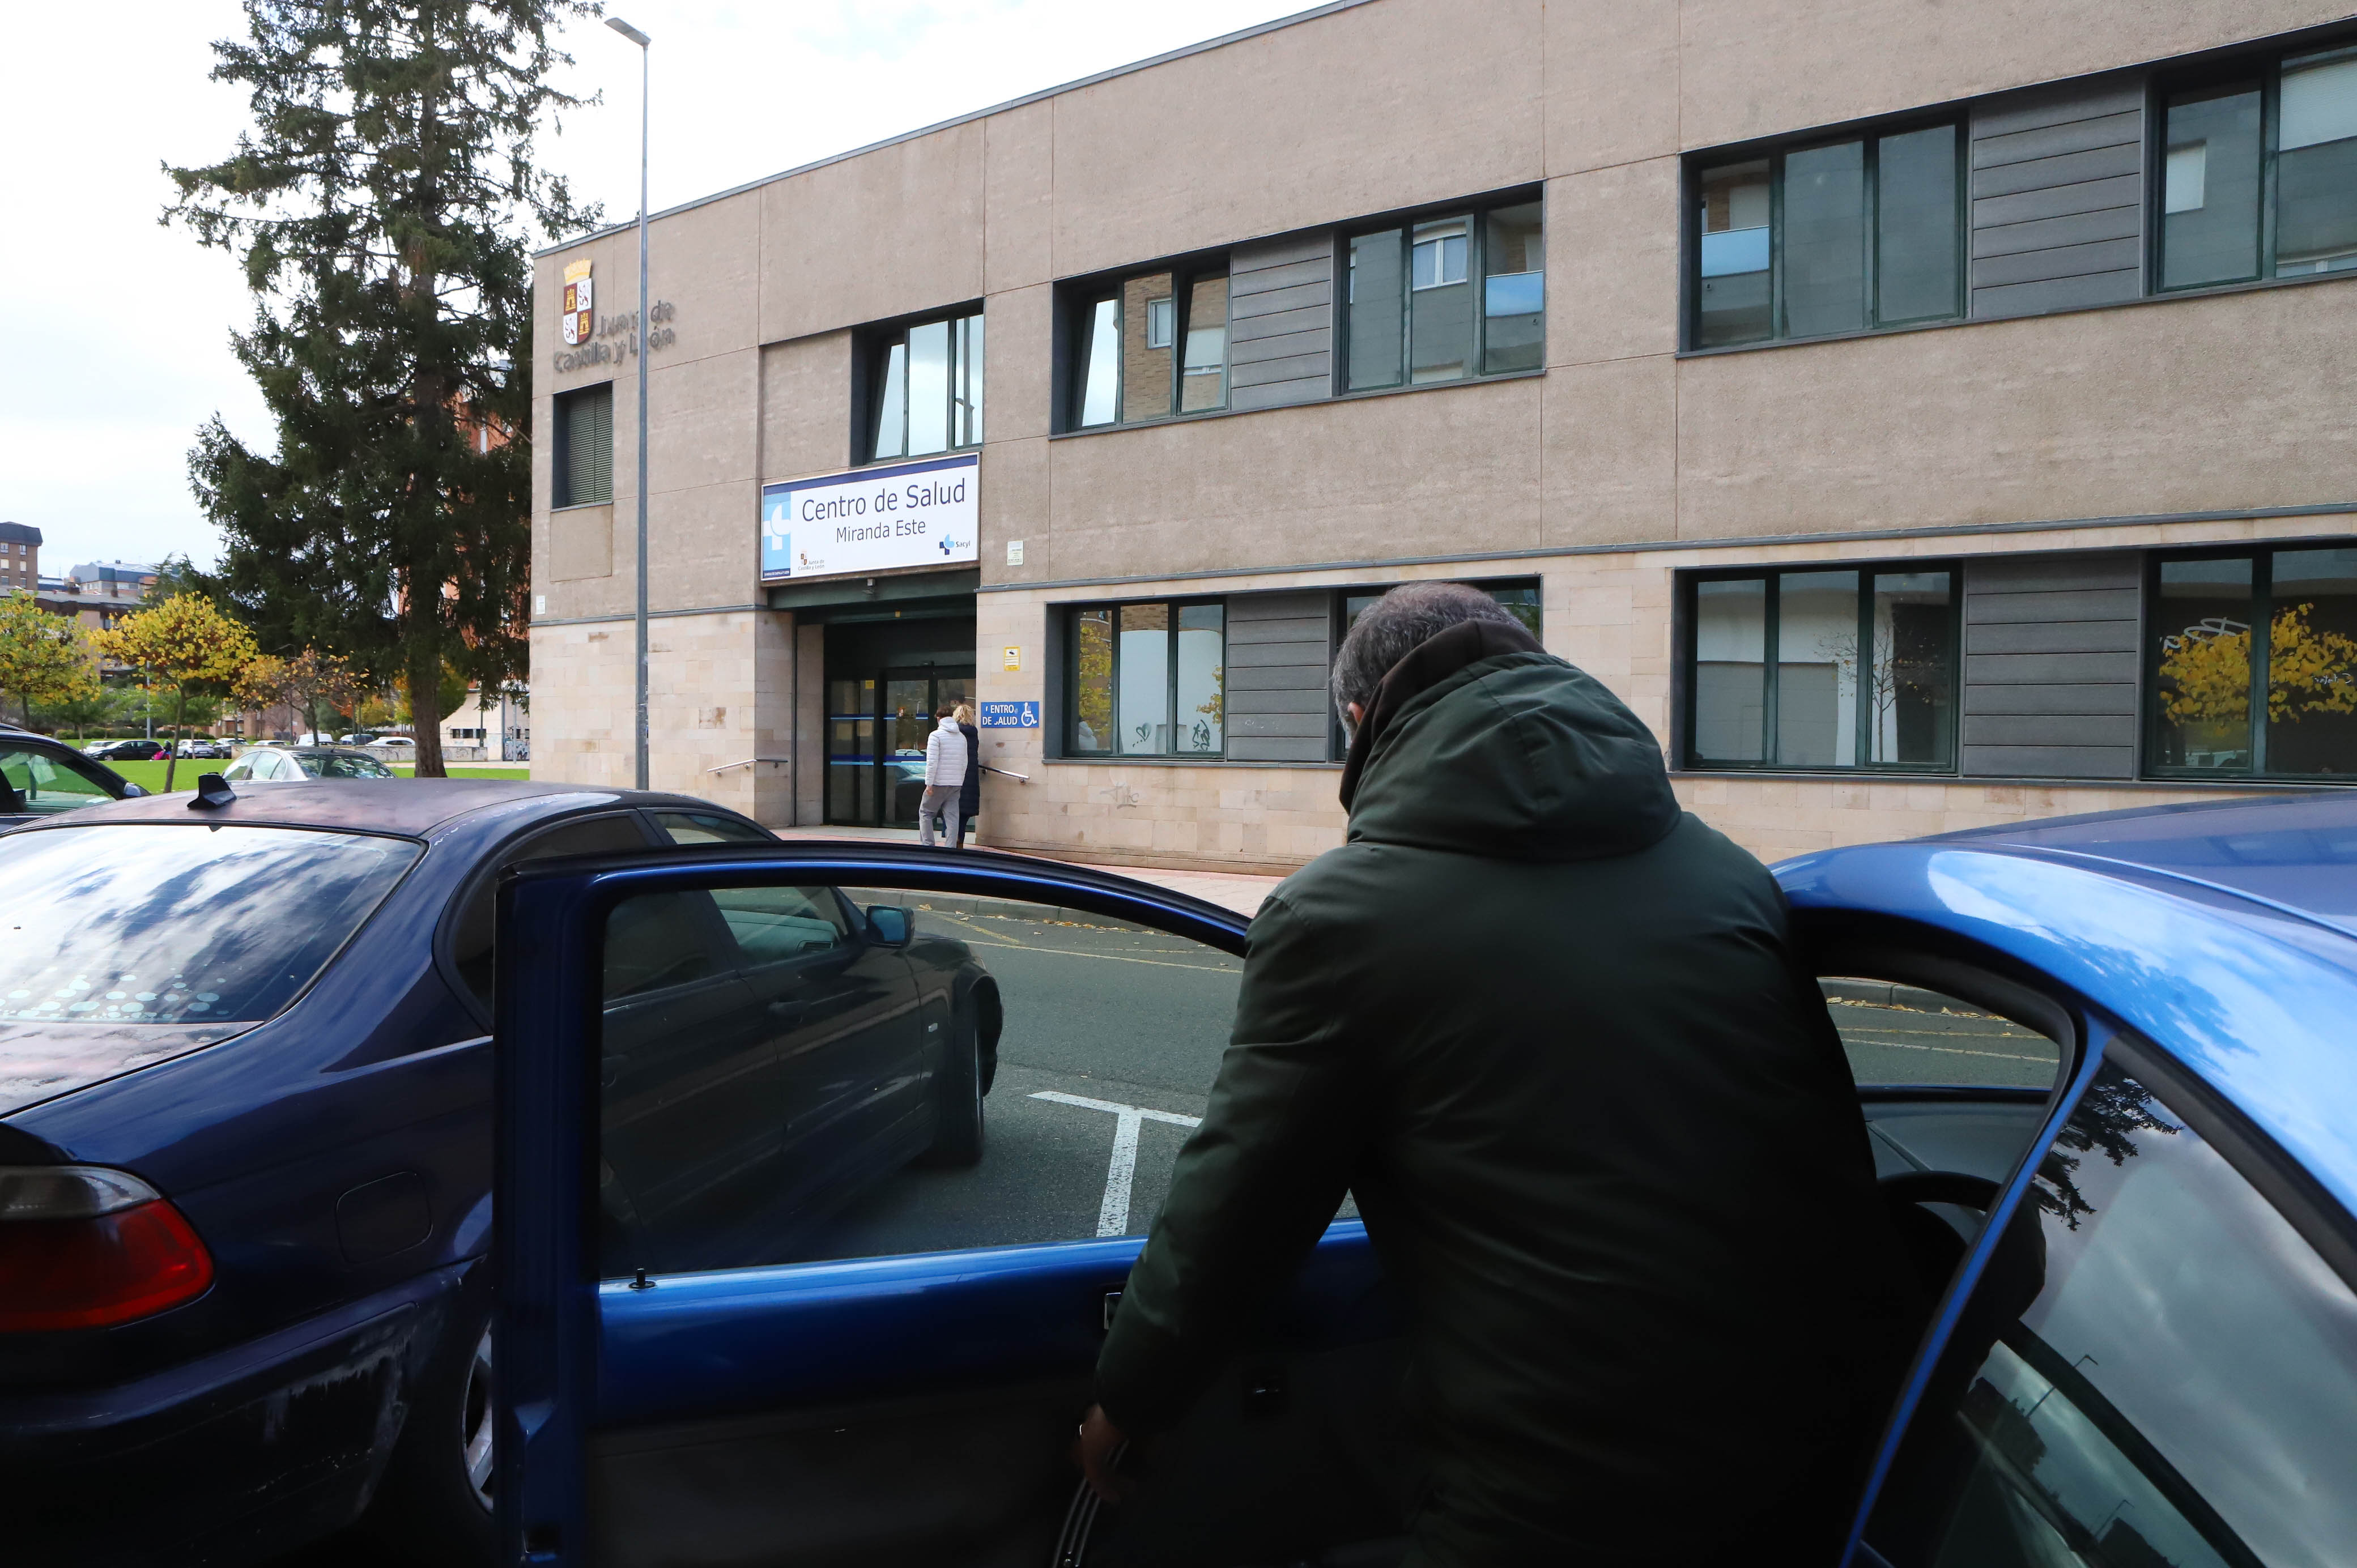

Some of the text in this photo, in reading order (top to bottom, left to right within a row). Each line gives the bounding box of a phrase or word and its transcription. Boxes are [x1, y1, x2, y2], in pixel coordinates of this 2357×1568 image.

[650, 300, 674, 322] de
[554, 326, 675, 372] Castilla y Lón
[802, 478, 965, 522] Centro de Salud
[836, 519, 926, 543] Miranda Este
[982, 716, 992, 725] DE
